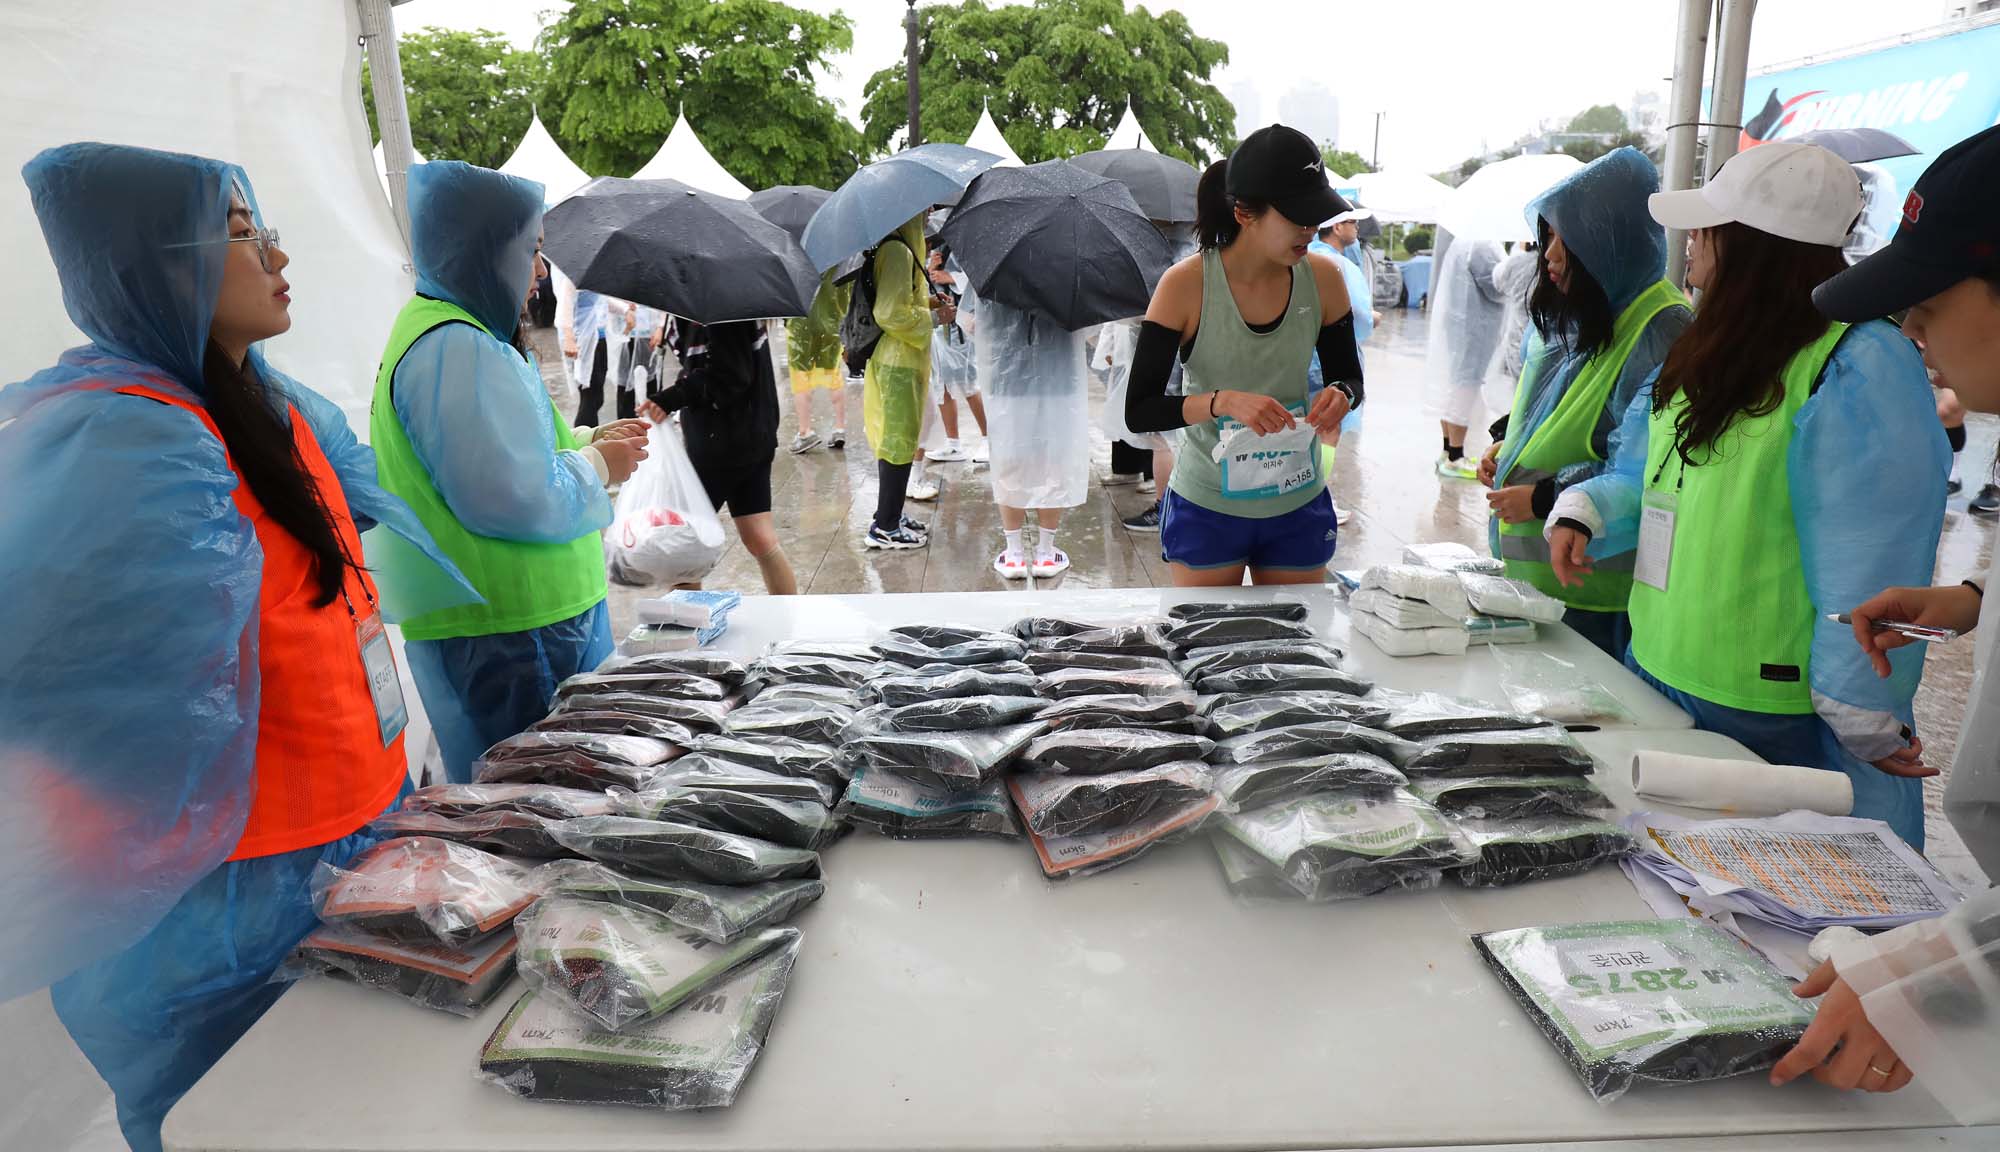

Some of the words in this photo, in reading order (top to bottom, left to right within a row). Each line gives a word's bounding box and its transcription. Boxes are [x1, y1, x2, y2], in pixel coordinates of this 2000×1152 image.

[374, 664, 394, 691] STAFF
[865, 783, 899, 797] 10km
[1059, 844, 1087, 857] 5km
[540, 927, 562, 940] 7km
[1567, 966, 1699, 997] 2875
[1593, 1018, 1634, 1033] 7km
[521, 1028, 556, 1040] 7km
